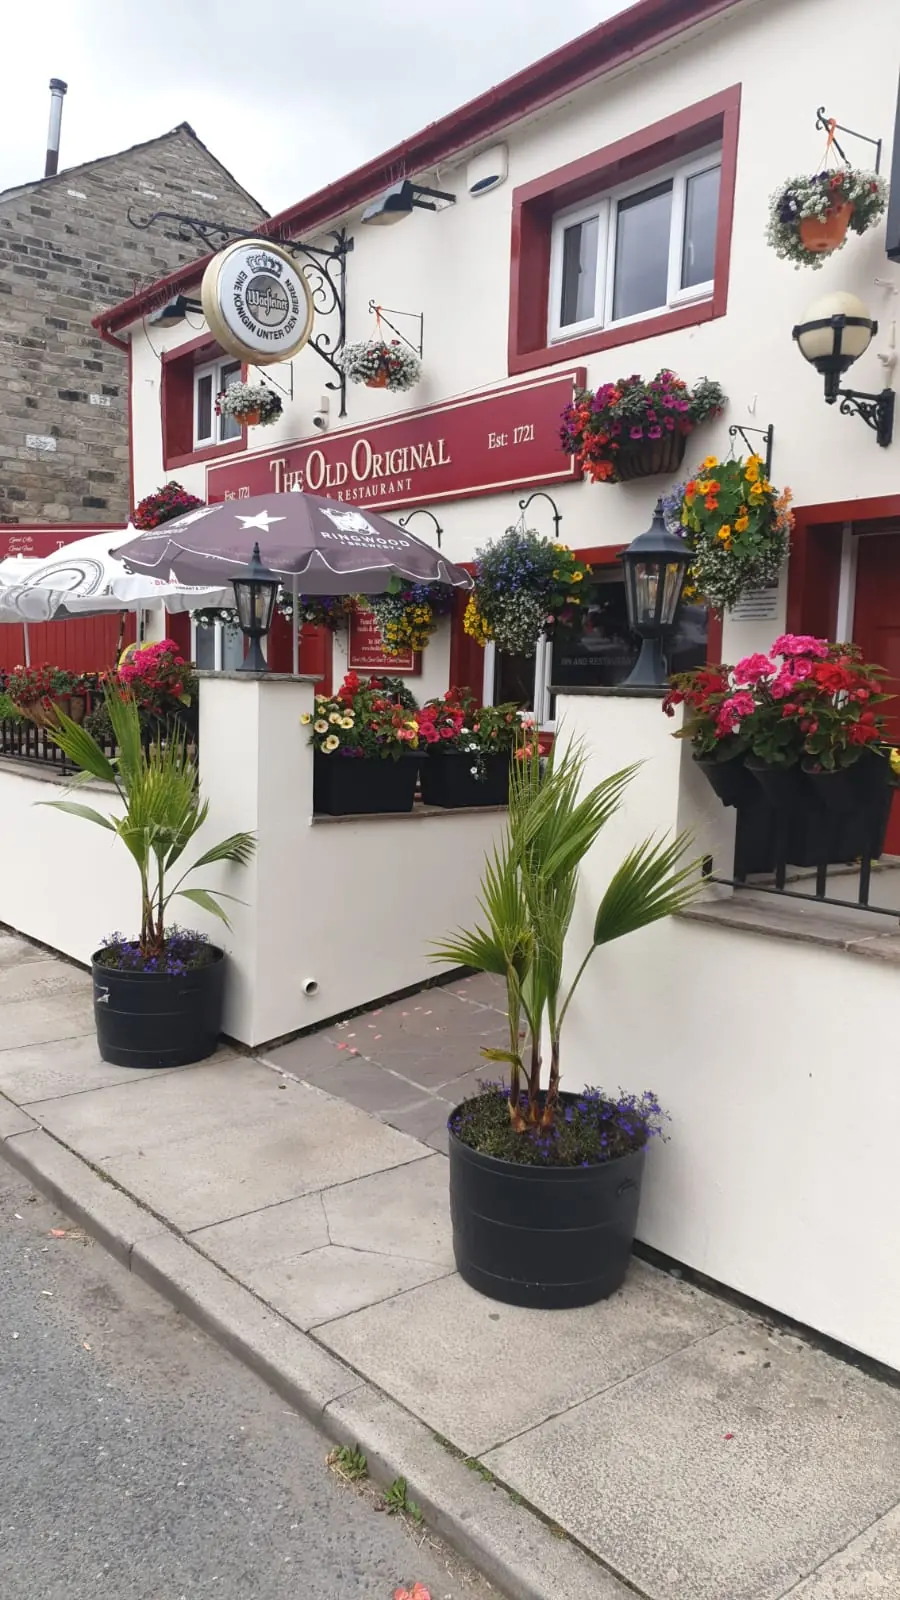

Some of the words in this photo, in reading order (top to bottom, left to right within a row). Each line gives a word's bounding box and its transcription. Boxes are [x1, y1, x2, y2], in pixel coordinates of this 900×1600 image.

[234, 270, 248, 292] EINE
[284, 278, 300, 315] BIEREN
[233, 293, 257, 333] KÖNIGIN
[284, 315, 298, 334] DEN
[256, 327, 285, 340] UNTER
[488, 431, 509, 449] Est:
[512, 423, 535, 444] 1721
[337, 477, 413, 502] RESTAURANT
[320, 531, 411, 548] RINGWOOD
